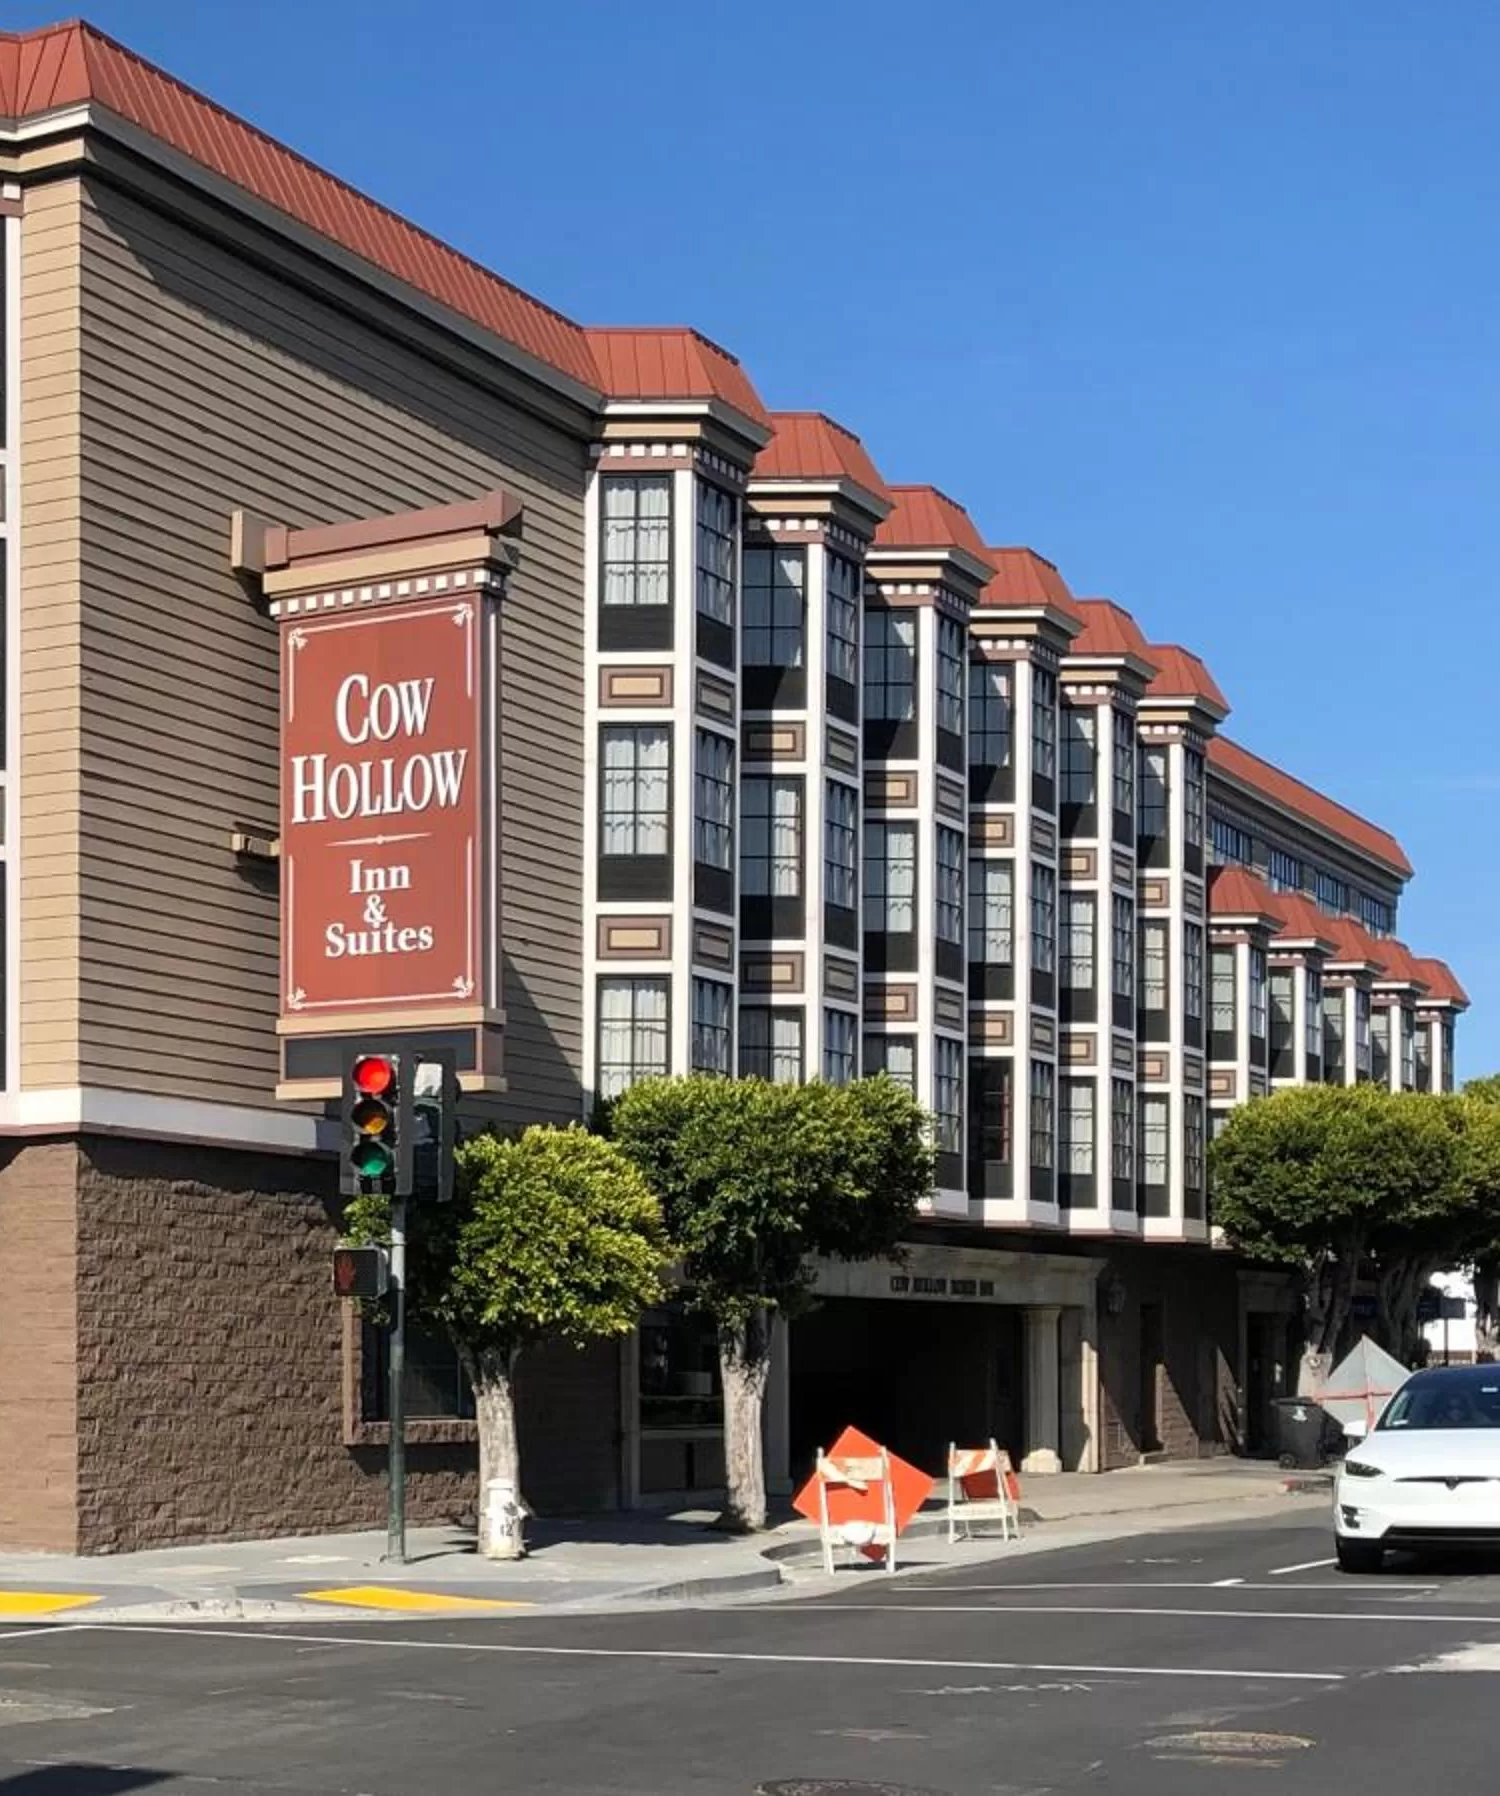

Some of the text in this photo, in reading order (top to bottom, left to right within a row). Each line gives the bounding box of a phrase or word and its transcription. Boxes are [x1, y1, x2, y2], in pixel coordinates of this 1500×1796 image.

[336, 673, 435, 746] COW
[291, 748, 469, 824] HOLLOW
[349, 859, 410, 894] Inn
[364, 895, 387, 922] &
[324, 919, 434, 958] Suites
